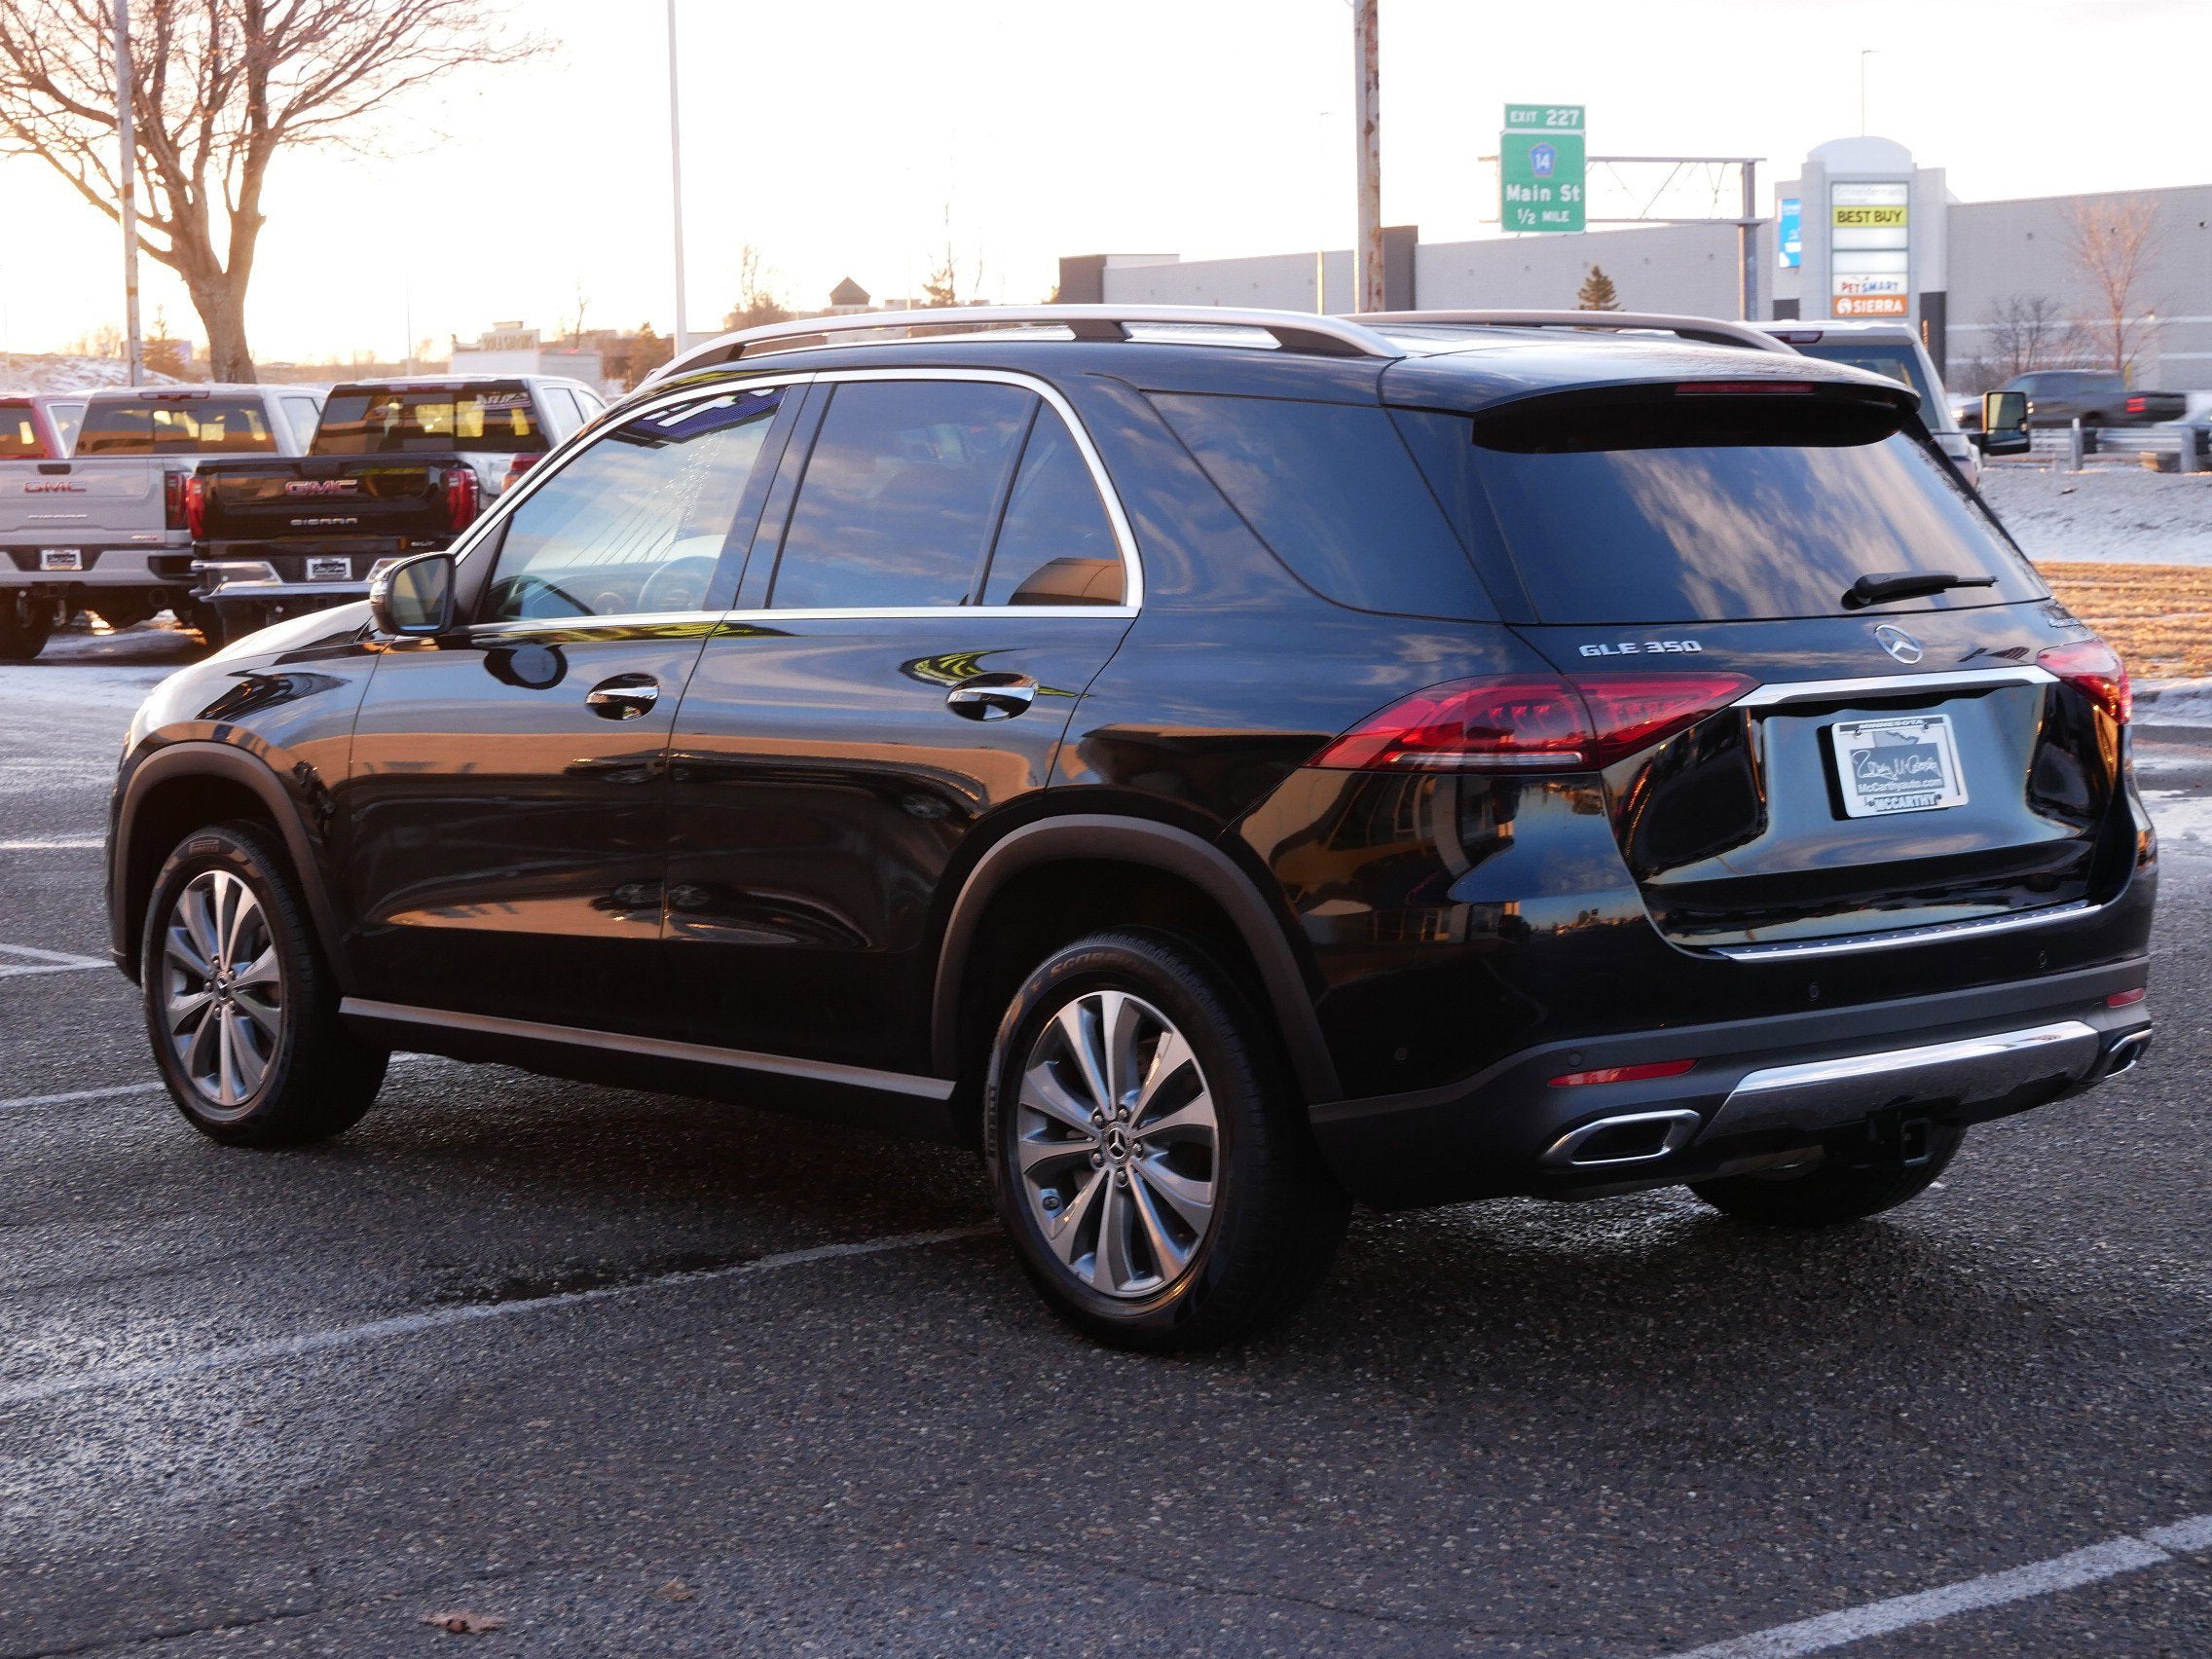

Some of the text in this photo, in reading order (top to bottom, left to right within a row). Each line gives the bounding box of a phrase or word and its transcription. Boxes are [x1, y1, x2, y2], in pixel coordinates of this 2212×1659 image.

[1509, 109, 1580, 127] EXIT 227
[1534, 152, 1551, 170] 14
[1506, 183, 1581, 203] Main St
[1541, 209, 1569, 222] MILE
[1836, 209, 1902, 223] BEST BUY
[1854, 298, 1903, 313] SIERRA
[23, 481, 87, 493] GMC
[284, 479, 358, 496] GMC
[1578, 640, 1703, 657] GLE 350
[1873, 793, 1937, 812] MCCARTHY
